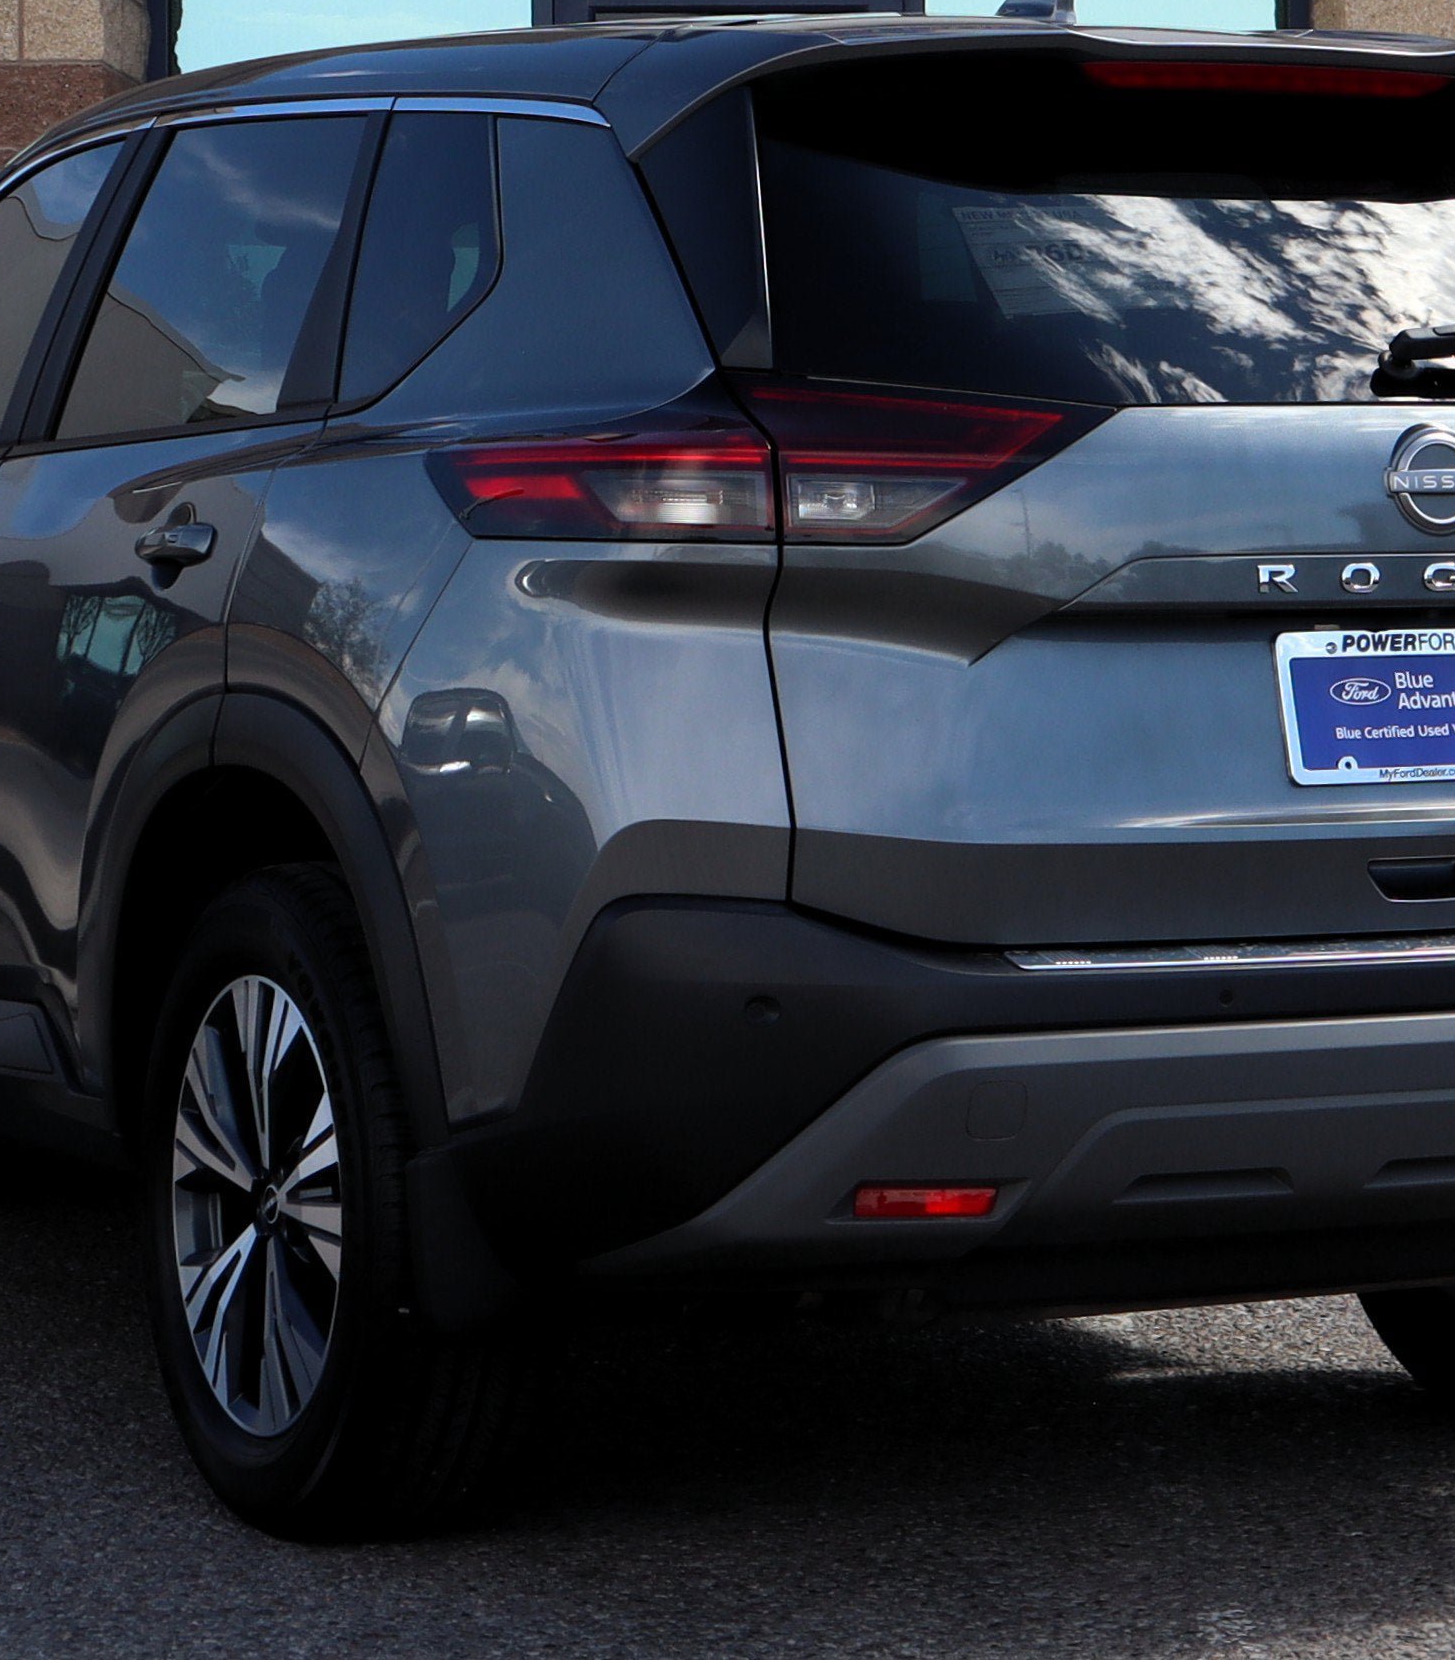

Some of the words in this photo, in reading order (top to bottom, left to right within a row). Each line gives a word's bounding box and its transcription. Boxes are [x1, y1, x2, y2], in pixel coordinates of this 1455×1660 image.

[1394, 671, 1434, 689] Blue
[1341, 681, 1380, 701] Ford
[1335, 727, 1362, 739] Blue
[1364, 725, 1415, 739] Certified
[1417, 723, 1450, 737] Used
